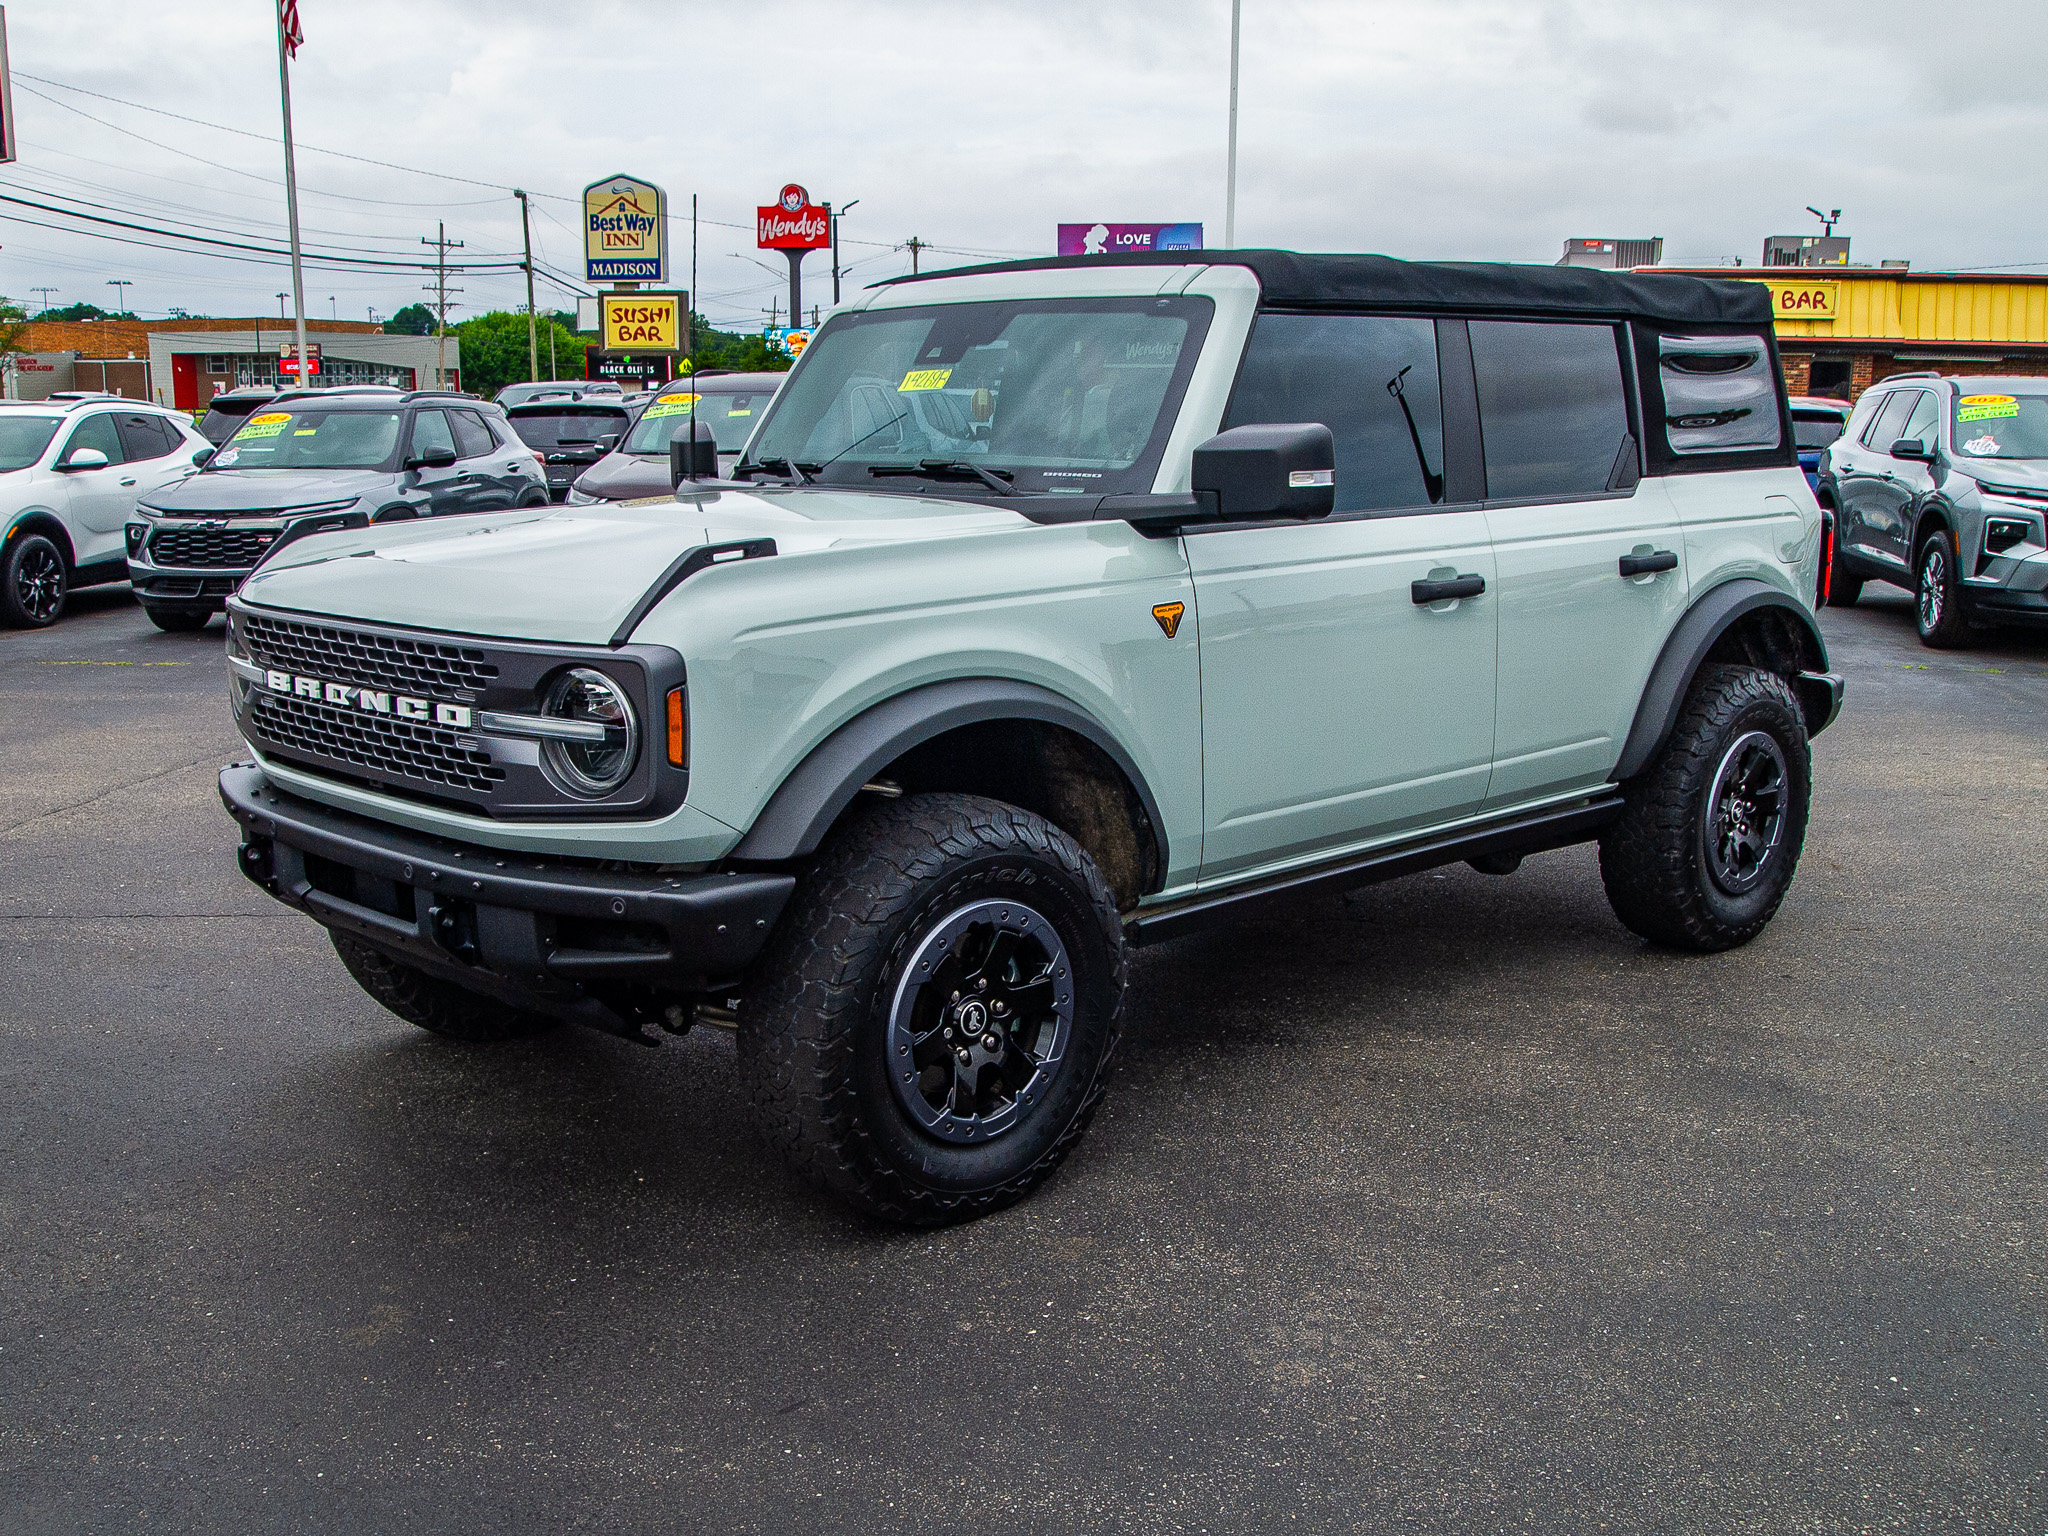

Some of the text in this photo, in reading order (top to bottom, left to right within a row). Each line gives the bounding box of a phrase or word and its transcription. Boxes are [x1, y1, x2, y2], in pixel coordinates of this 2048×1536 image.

[589, 213, 656, 237] Best Way
[760, 212, 826, 242] Wendy's
[606, 232, 640, 247] INN
[1116, 233, 1151, 245] LOVE
[591, 263, 657, 276] MADISON
[1781, 290, 1828, 310] BAR
[612, 307, 670, 324] SUSHI
[619, 325, 663, 342] BAR
[600, 365, 625, 374] BLACK
[266, 668, 473, 730] BRONCO
